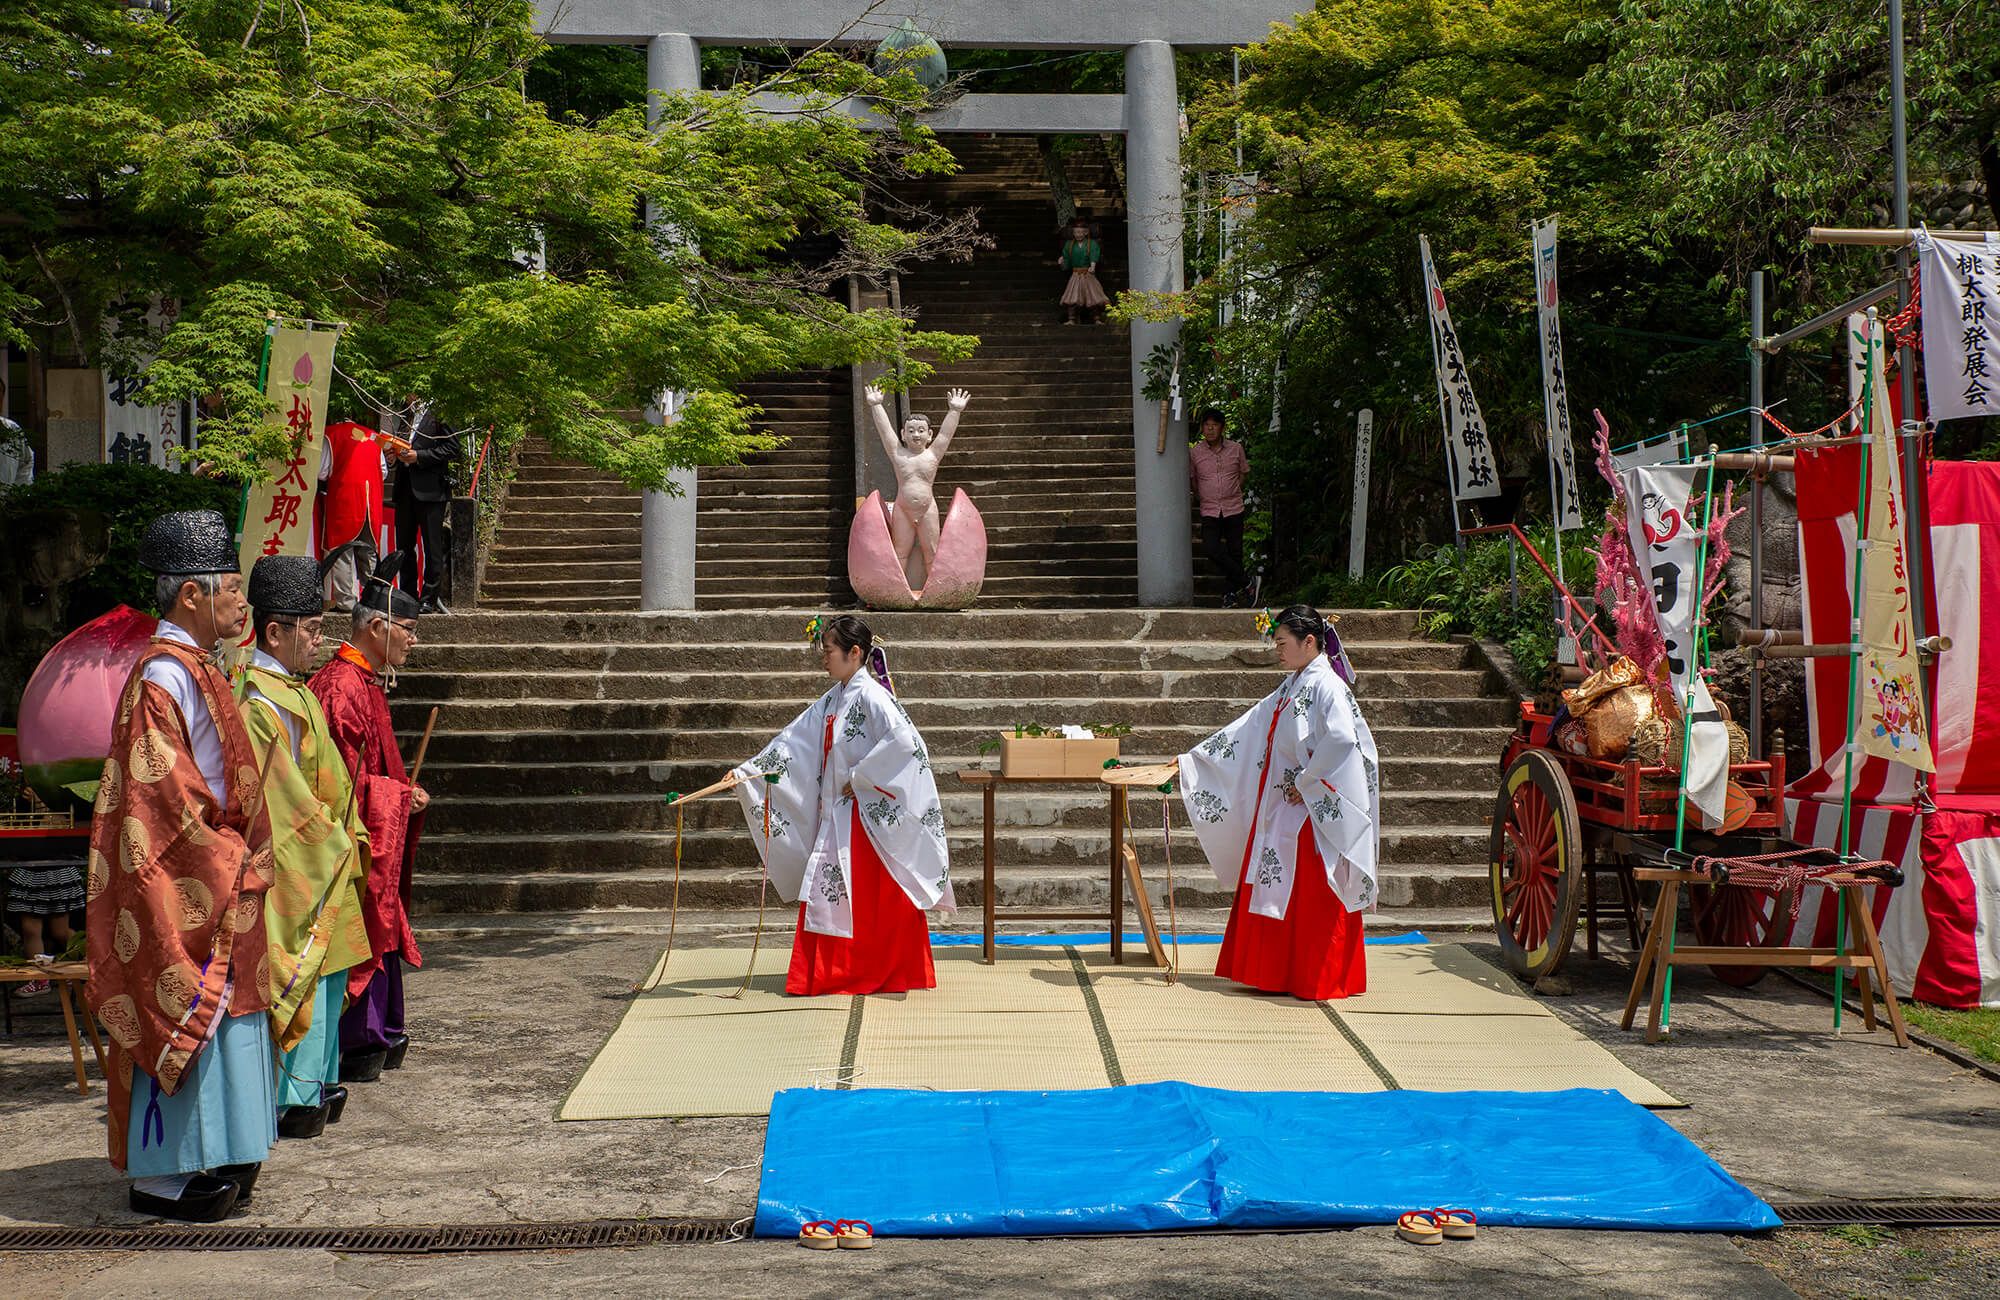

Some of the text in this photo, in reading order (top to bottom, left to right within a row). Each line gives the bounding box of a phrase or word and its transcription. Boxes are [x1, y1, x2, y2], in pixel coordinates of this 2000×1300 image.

[1956, 253, 1991, 405] 桃太郎発展会
